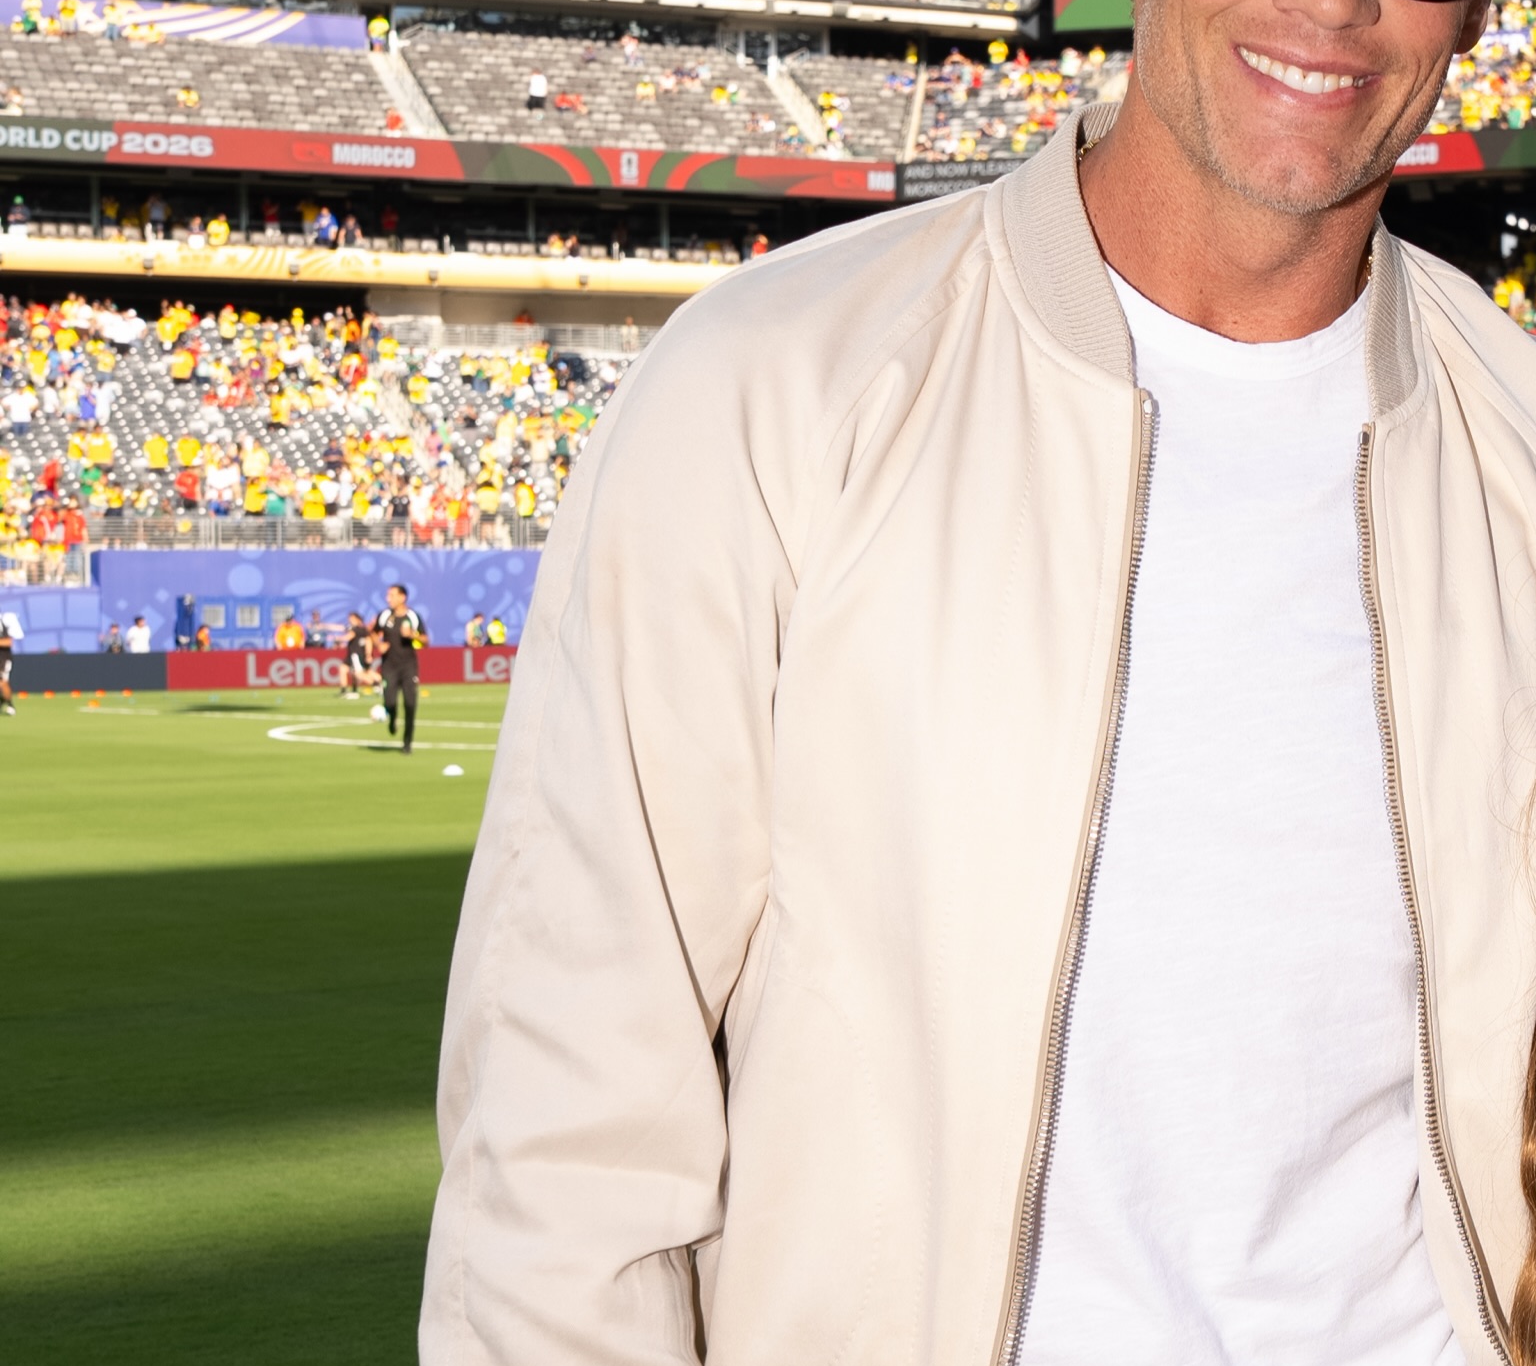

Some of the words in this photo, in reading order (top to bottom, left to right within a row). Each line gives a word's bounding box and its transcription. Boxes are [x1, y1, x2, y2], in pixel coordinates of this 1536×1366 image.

[64, 129, 119, 152] CUP
[121, 131, 214, 157] 2026
[332, 142, 416, 169] MOROCCO
[904, 163, 935, 180] AND
[935, 162, 970, 178] NOW
